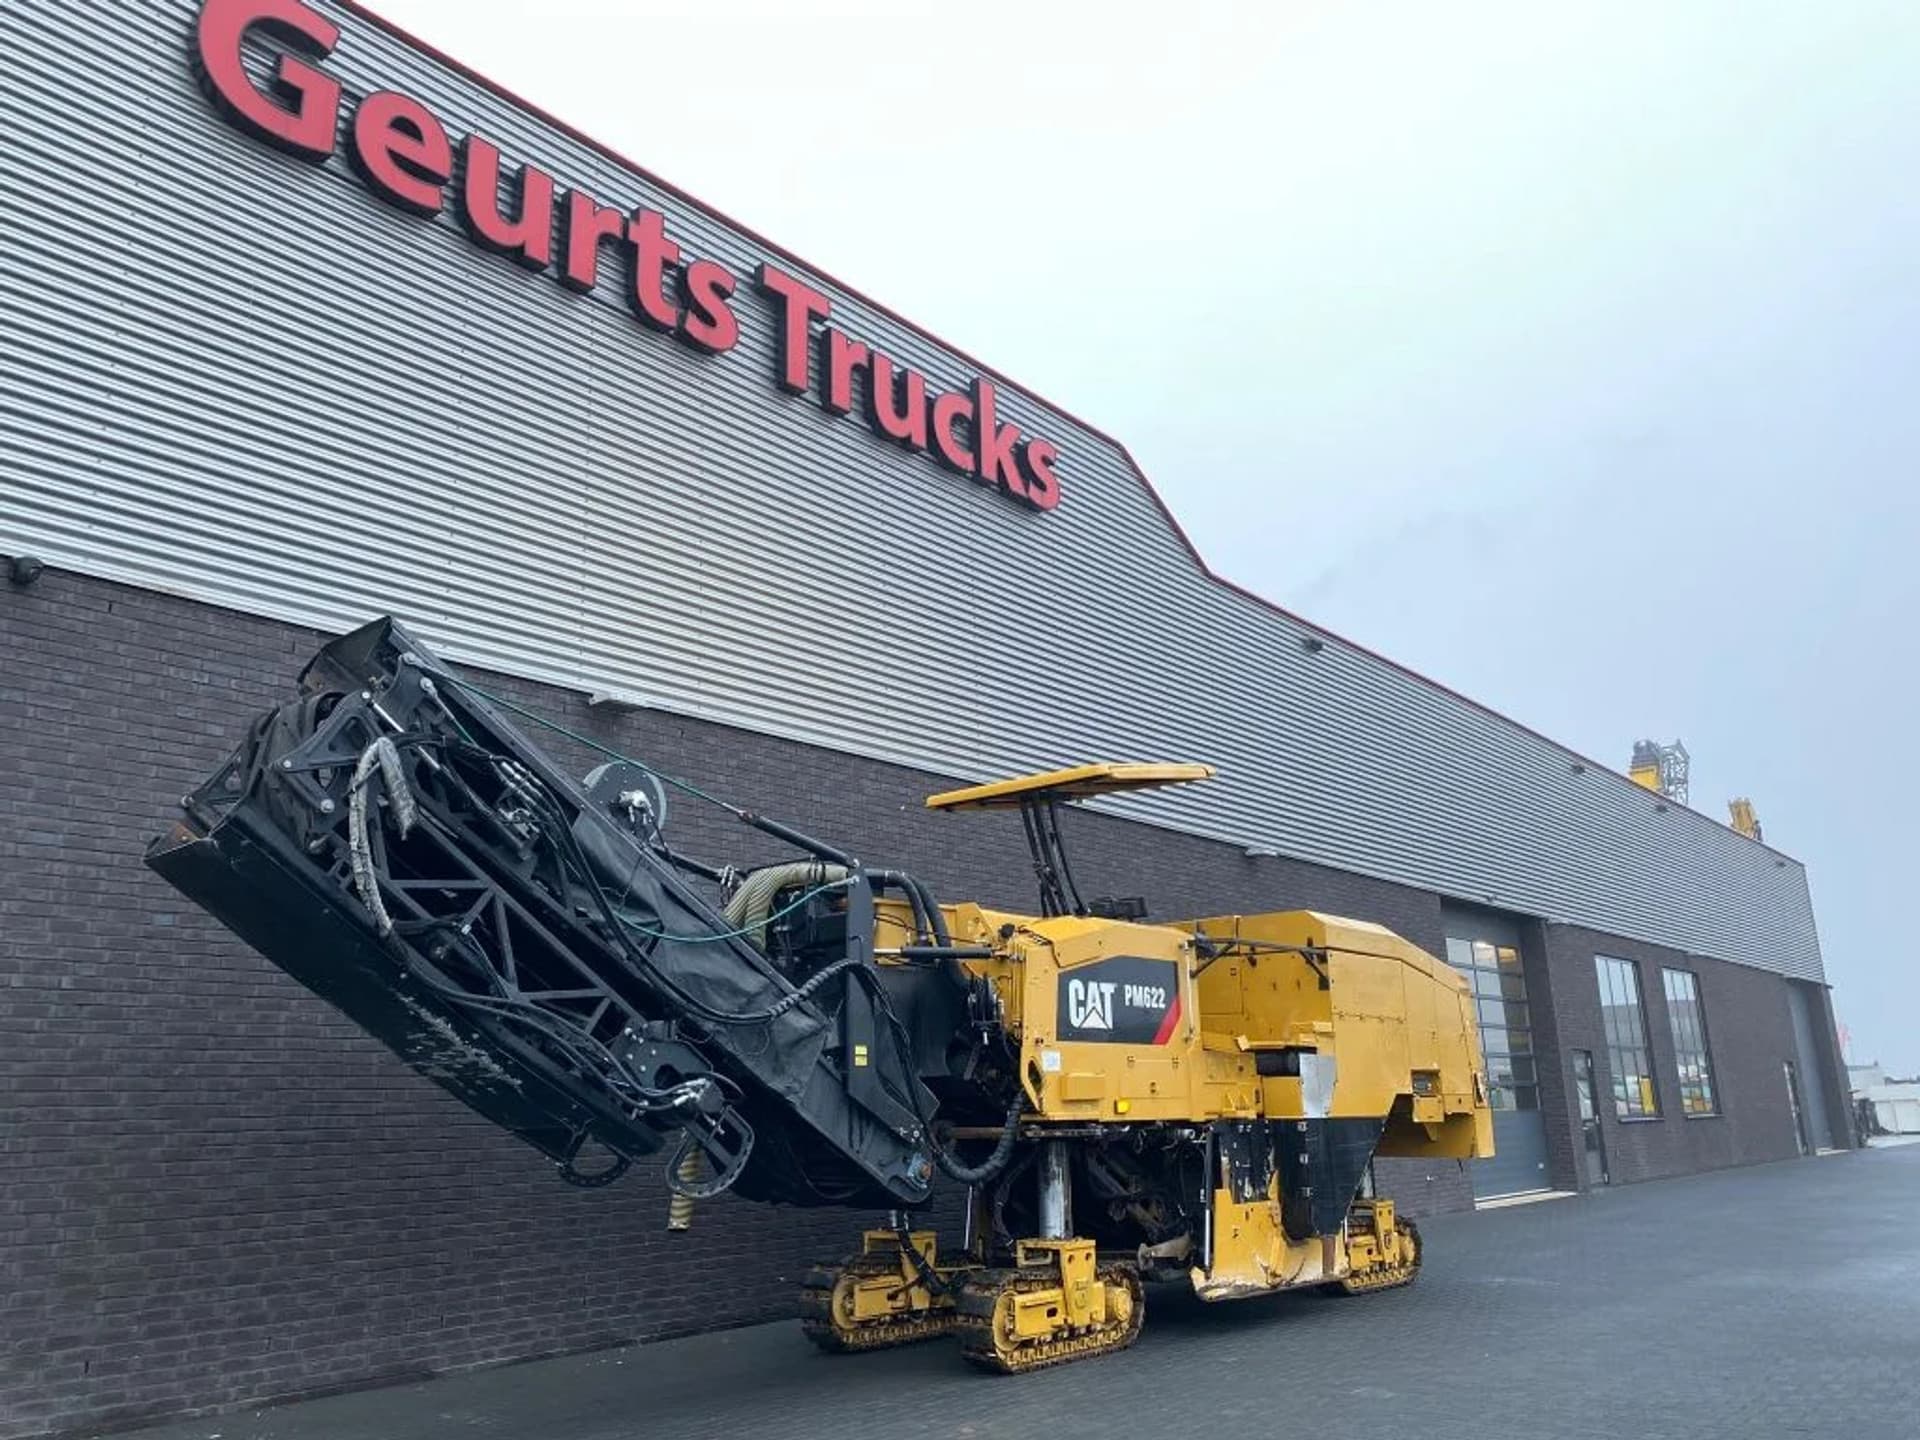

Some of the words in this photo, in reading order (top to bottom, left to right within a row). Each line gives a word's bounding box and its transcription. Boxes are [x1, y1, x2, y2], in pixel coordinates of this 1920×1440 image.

[195, 0, 740, 353] Geurts
[760, 262, 1061, 511] Trucks
[1068, 978, 1118, 1030] CAT
[1124, 984, 1166, 1009] PM622
